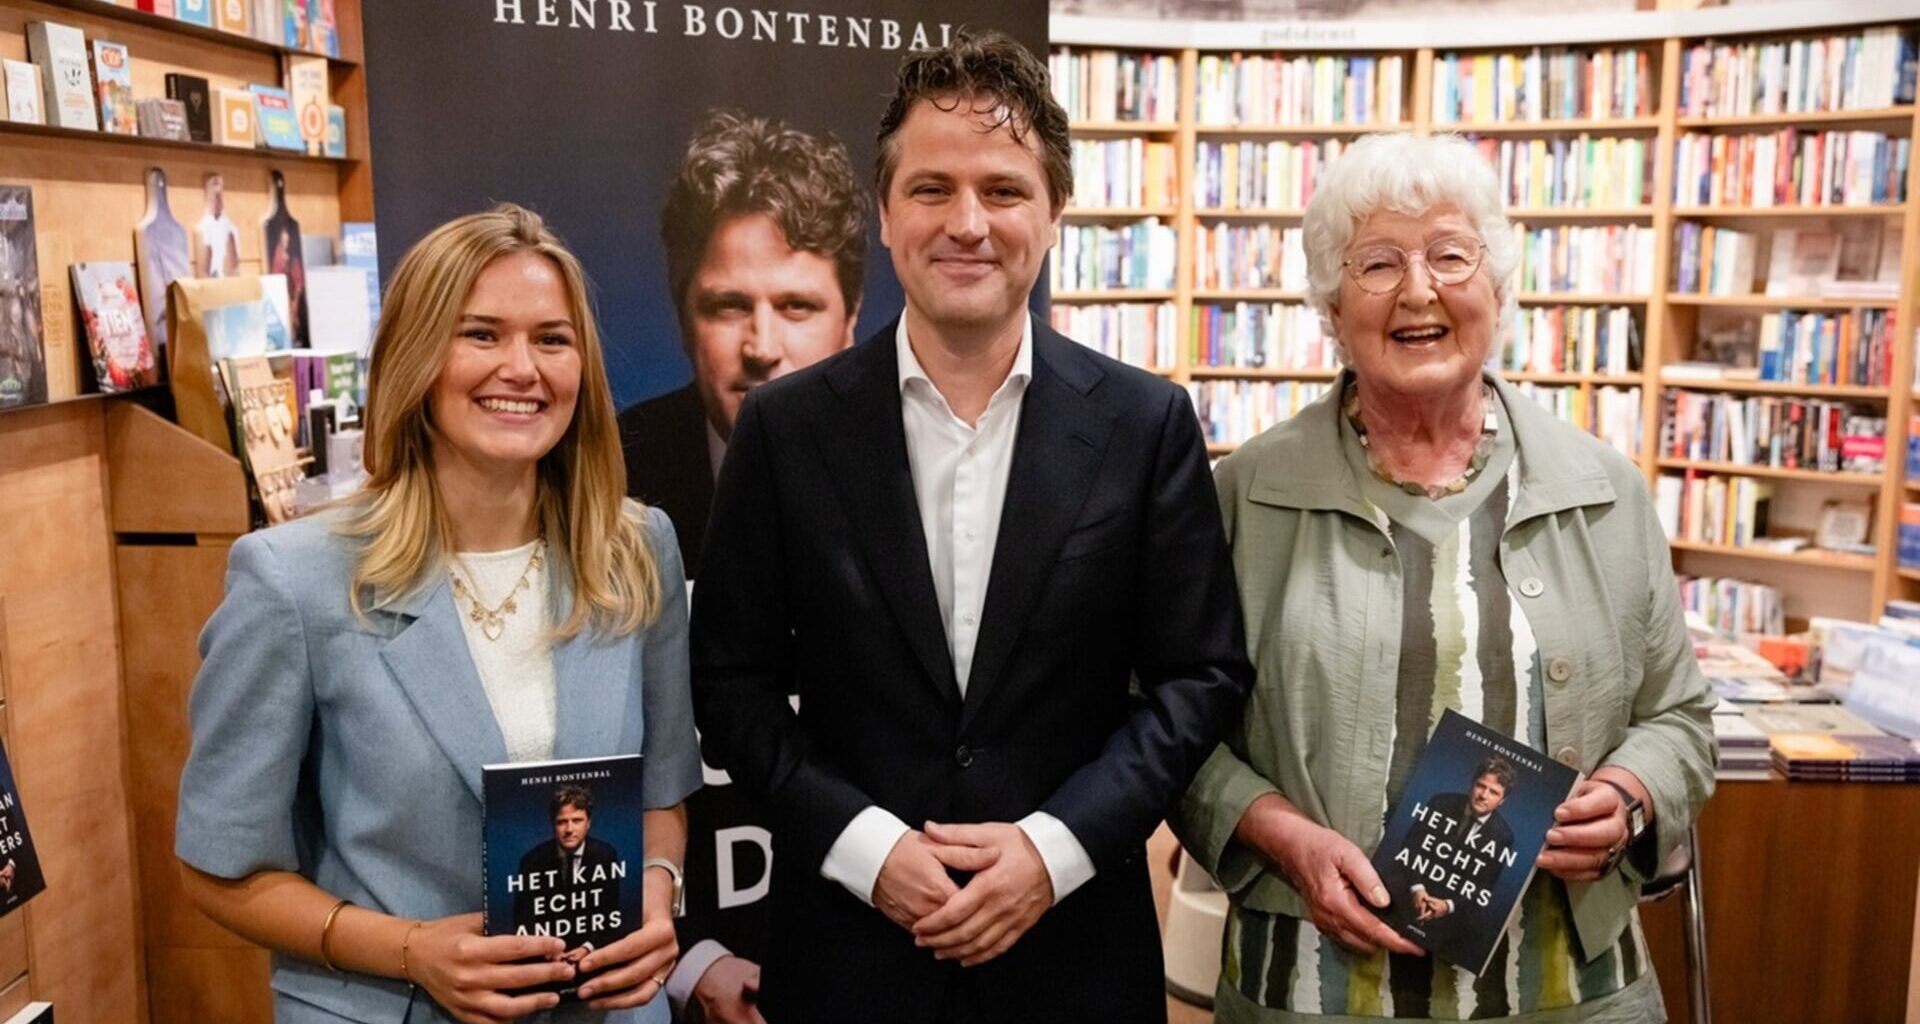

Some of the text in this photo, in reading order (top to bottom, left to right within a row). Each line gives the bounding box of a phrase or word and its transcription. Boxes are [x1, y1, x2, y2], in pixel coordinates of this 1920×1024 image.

[494, 0, 658, 33] HENRI
[1465, 730, 1543, 773] HENRI BONTENBAL
[521, 769, 611, 786] HENRI BONTENBAL
[0, 831, 22, 854] ERS
[1411, 802, 1518, 867] HET KAN
[1421, 834, 1486, 876] ECHT
[507, 861, 626, 893] HET KAN
[1395, 847, 1492, 906] ANDERS
[534, 888, 603, 915] ECHT
[516, 910, 622, 937] ANDERS
